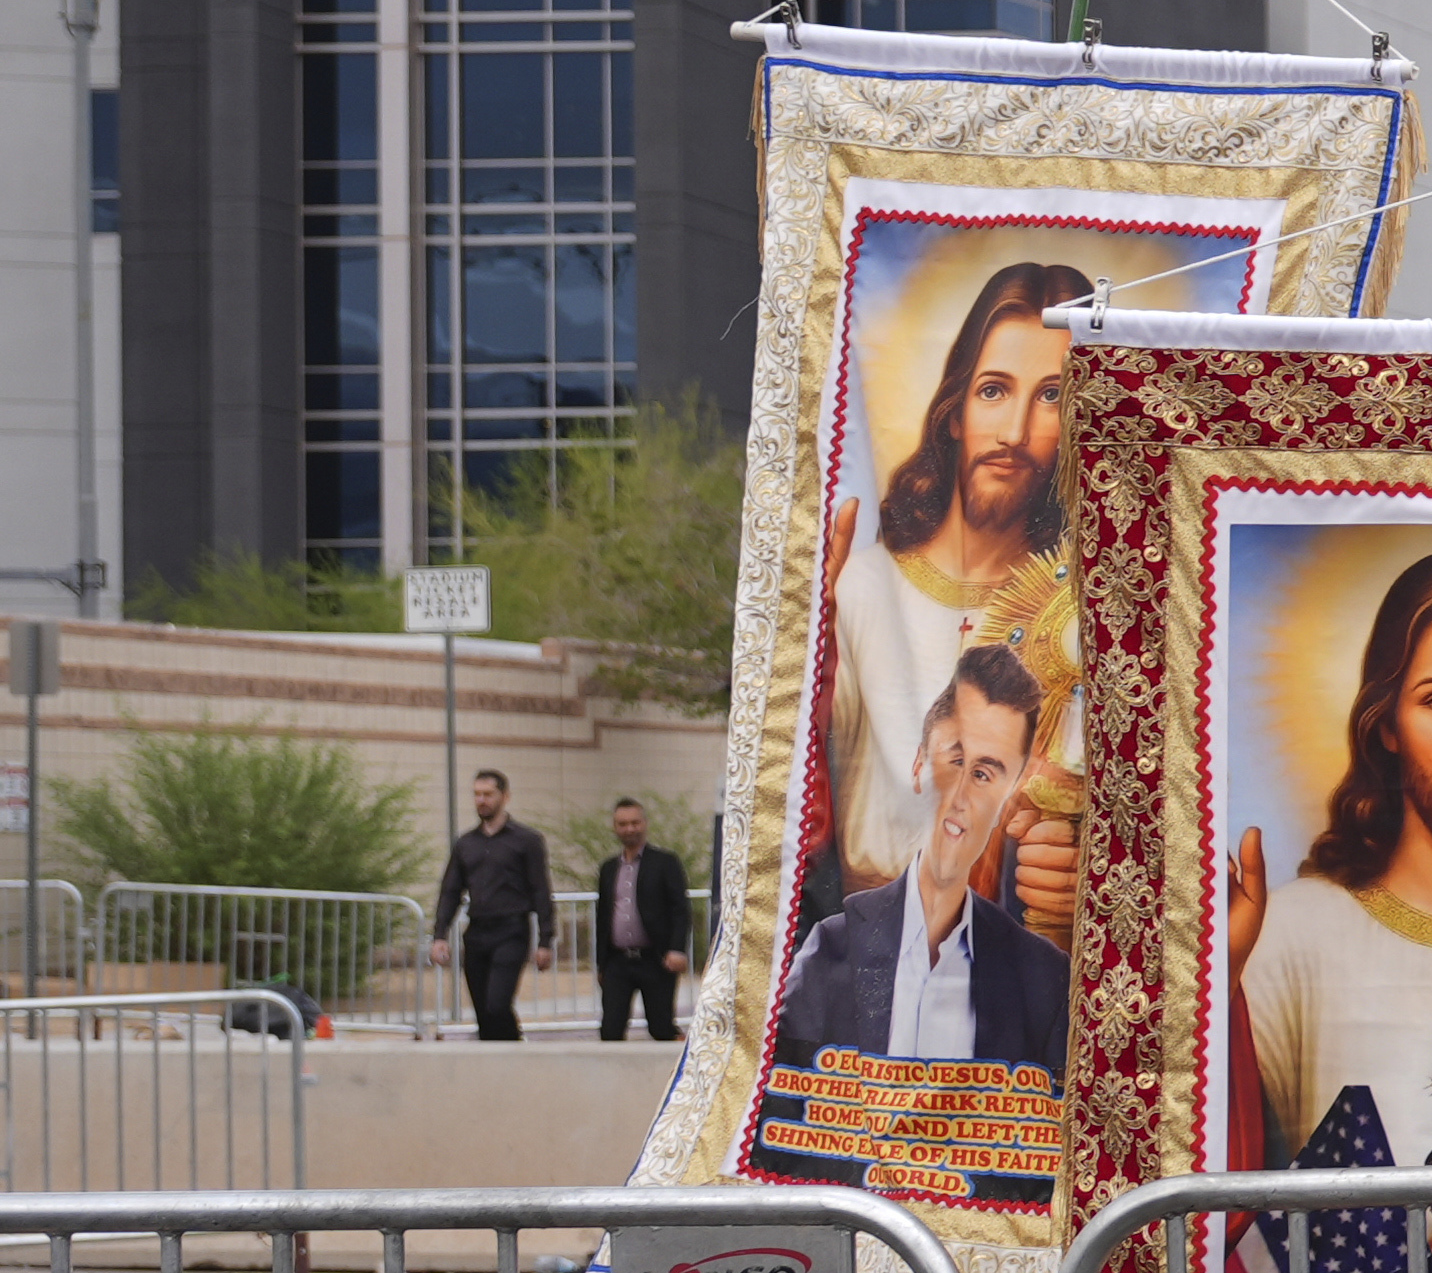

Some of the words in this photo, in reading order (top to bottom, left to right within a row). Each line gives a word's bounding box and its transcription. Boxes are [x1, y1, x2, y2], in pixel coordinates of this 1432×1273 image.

[410, 572, 483, 584] STADIUM
[423, 608, 470, 619] AREA
[821, 1052, 836, 1069] O
[929, 1067, 1010, 1089] JESUS,
[1017, 1070, 1050, 1092] OUR
[864, 1089, 911, 1108] RLIE
[913, 1093, 978, 1112] KIRK
[984, 1095, 1064, 1118] RETURN
[809, 1104, 863, 1127] HOME
[893, 1118, 948, 1137] AND
[956, 1121, 1015, 1141] LEFT
[1020, 1125, 1062, 1145] THE
[765, 1124, 854, 1153] SHINING
[910, 1146, 945, 1164] OF
[950, 1149, 991, 1167] HIS
[996, 1151, 1062, 1172] FAITH
[887, 1169, 966, 1193] ORLD.
